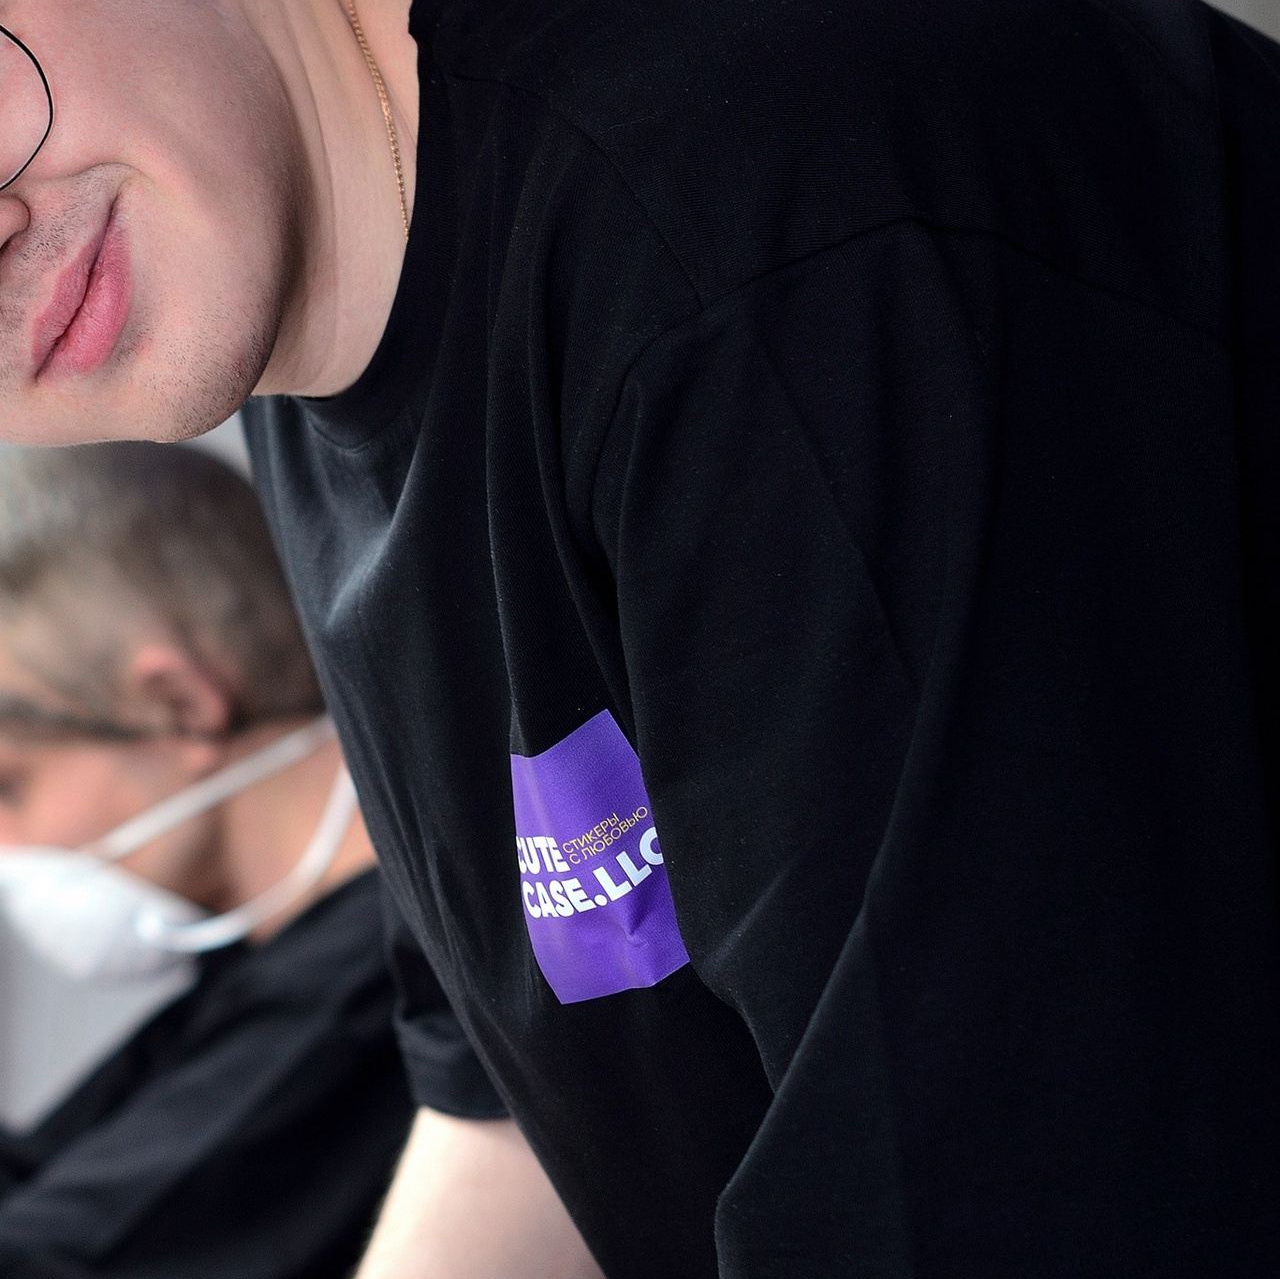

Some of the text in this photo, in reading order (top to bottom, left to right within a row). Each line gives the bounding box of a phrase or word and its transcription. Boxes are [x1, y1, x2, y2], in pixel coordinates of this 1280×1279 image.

[562, 812, 620, 854] СТИКЕРЫ
[569, 806, 648, 865] С ЛЮБОВЬЮ
